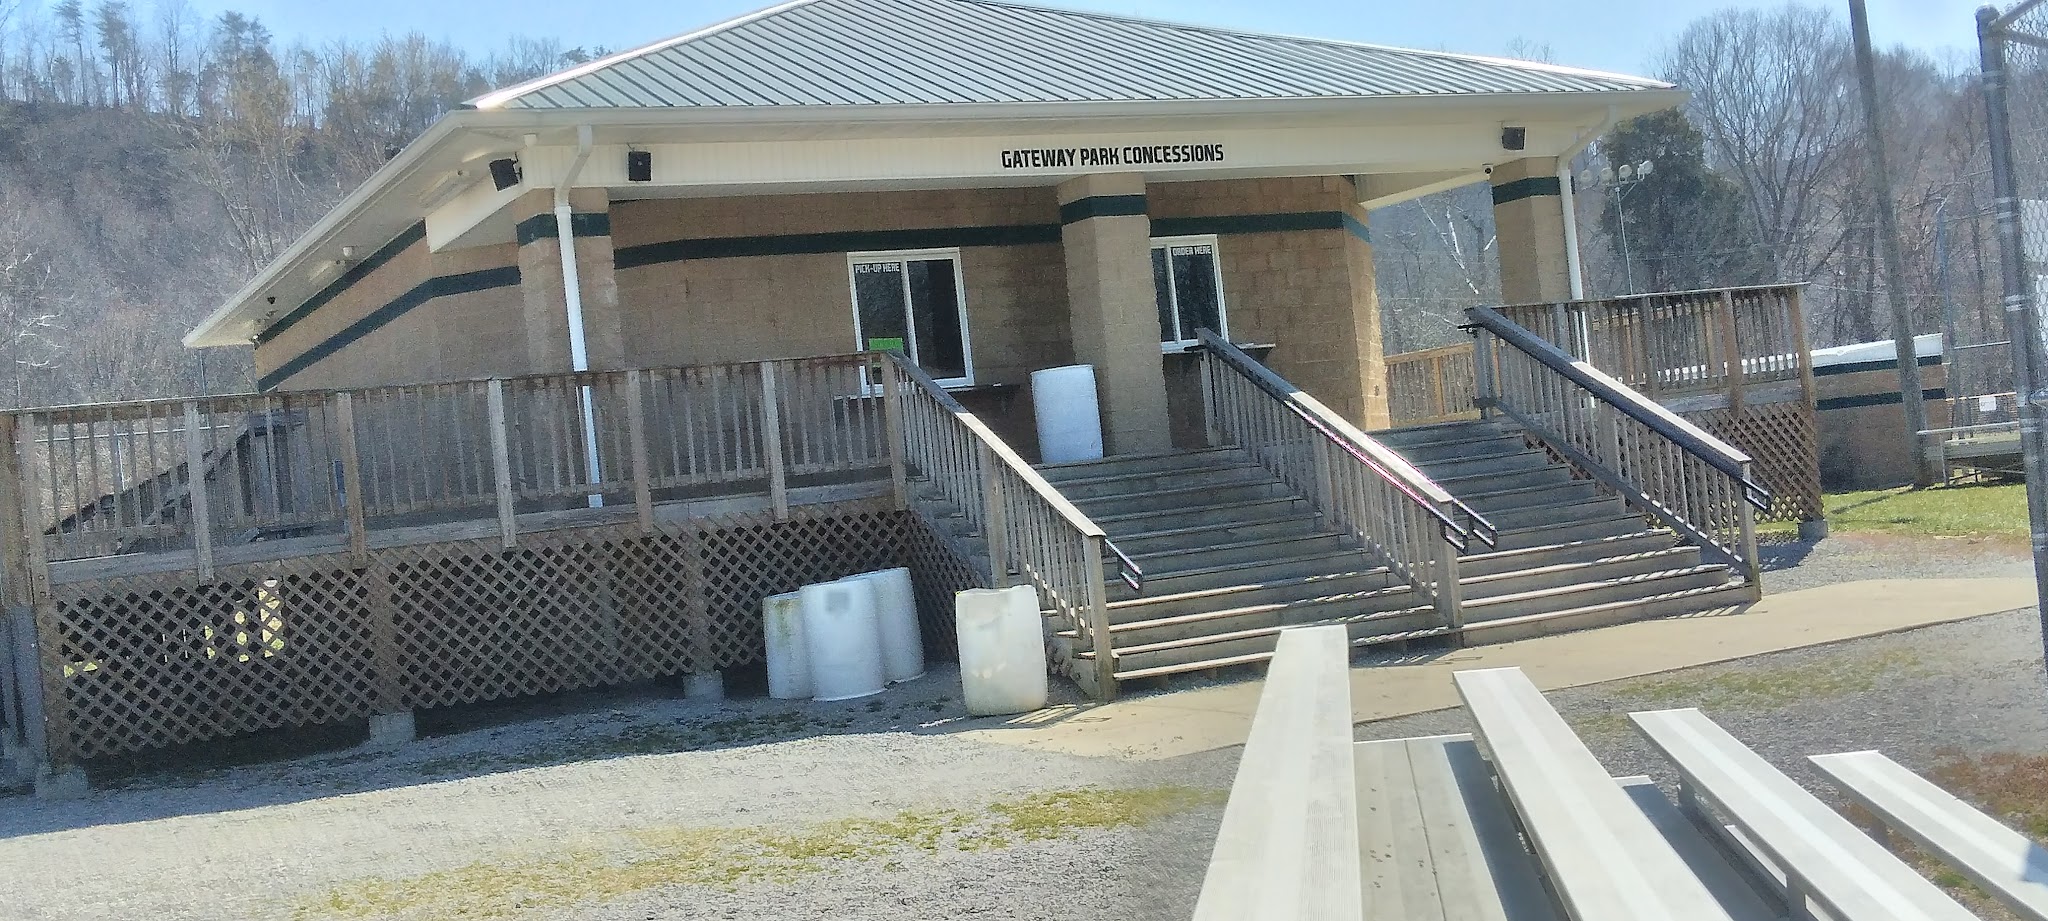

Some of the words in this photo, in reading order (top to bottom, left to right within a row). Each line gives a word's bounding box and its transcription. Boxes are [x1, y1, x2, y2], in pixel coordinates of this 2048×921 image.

[1001, 148, 1076, 168] GATEWAY
[1080, 147, 1119, 166] PARK
[1123, 144, 1224, 164] CONCESSIONS
[1172, 247, 1194, 256] ORDER
[1194, 245, 1211, 255] HERE
[855, 264, 882, 274] PICK-UP
[882, 263, 900, 273] HERE
